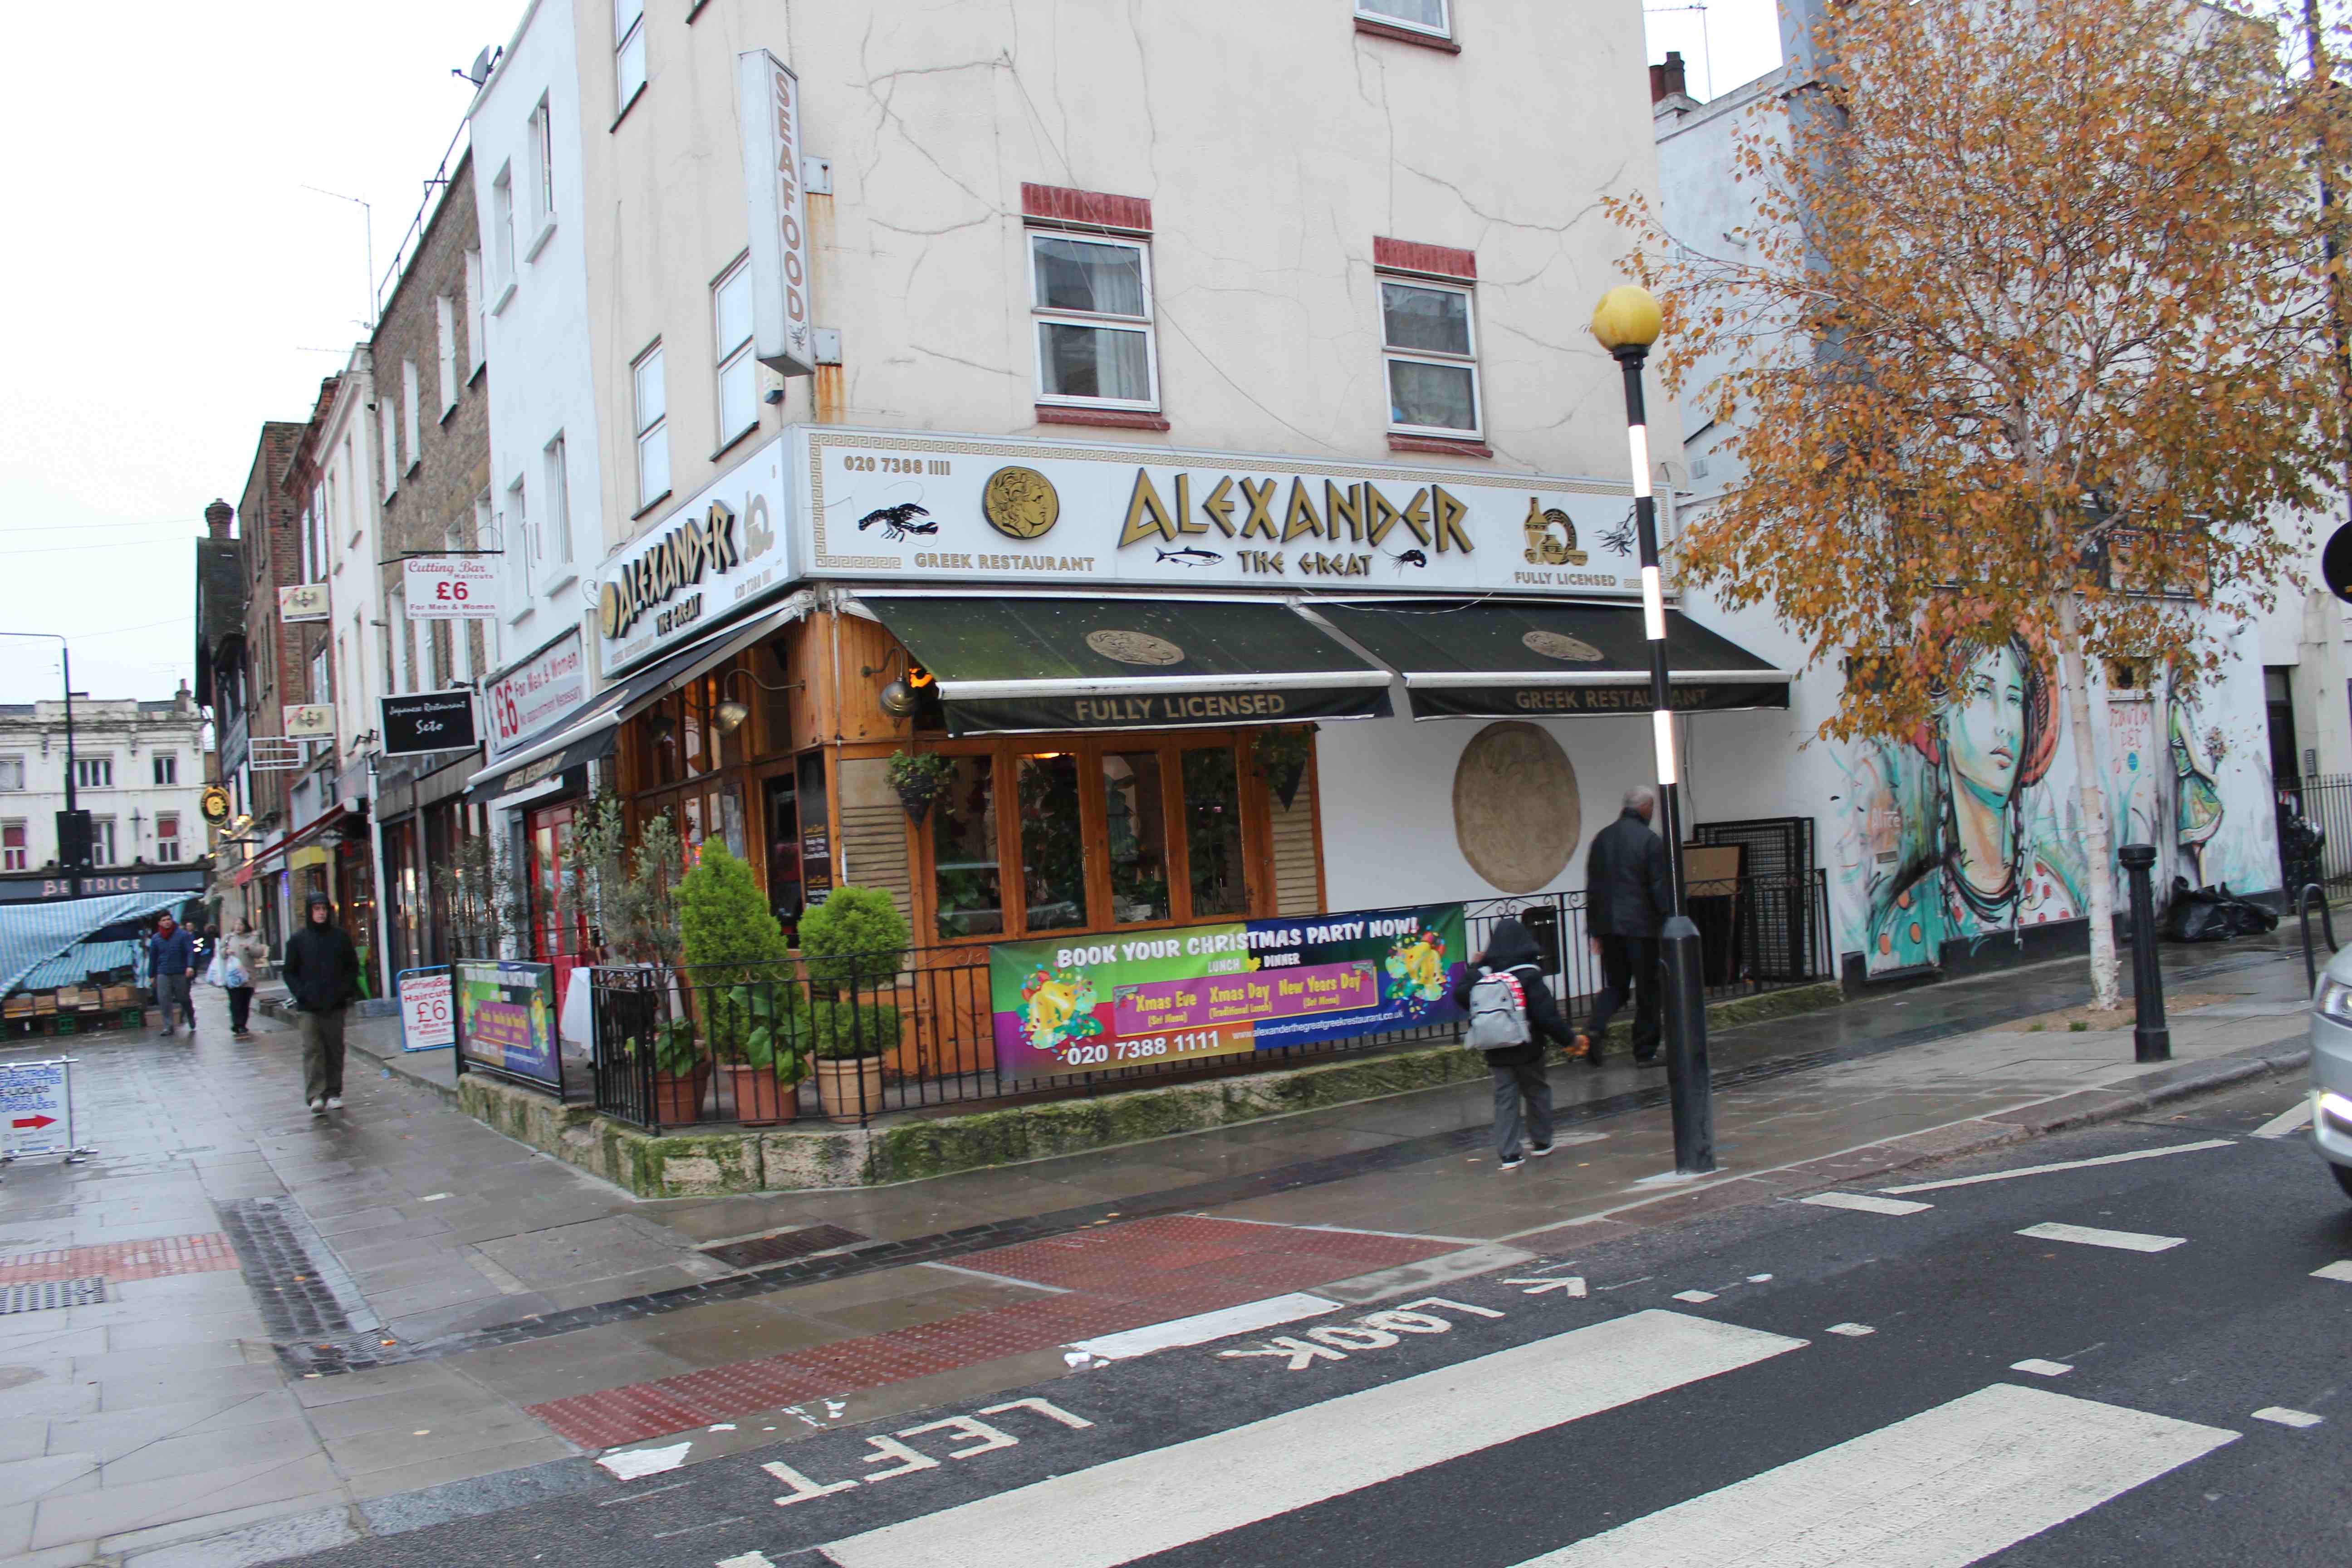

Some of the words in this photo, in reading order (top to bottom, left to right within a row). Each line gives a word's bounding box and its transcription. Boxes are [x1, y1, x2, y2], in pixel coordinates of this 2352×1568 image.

[775, 71, 804, 323] SEAFOOD
[844, 456, 875, 471] 020
[882, 457, 922, 474] 7388
[1117, 467, 1475, 554] ALEXANDER
[409, 560, 454, 576] Cutting
[459, 560, 486, 573] Bar
[618, 499, 739, 638] ALEXANDER
[915, 552, 973, 569] GREEK
[979, 554, 1095, 571] RESTAURANT
[1237, 550, 1285, 574] THE
[1298, 552, 1373, 576] GREAT
[436, 581, 469, 600] £6
[1514, 572, 1552, 585] FULLY
[1557, 573, 1616, 587] LICENSED
[495, 680, 518, 739] £6
[1075, 699, 1153, 721] FULLY
[1164, 694, 1286, 719] LICENSED
[1516, 689, 1580, 708] GREEK
[1585, 688, 1708, 708] RESTAANT
[415, 719, 444, 735] Seto
[42, 876, 140, 897] BETRICE
[1057, 944, 1117, 968] BOOK
[1122, 939, 1181, 959] YOUR
[1187, 928, 1302, 955] CHRISTMAS
[1307, 921, 1366, 945] PARTY
[1369, 916, 1419, 938] NOW!
[1208, 958, 1241, 973] LUNCH
[1263, 952, 1301, 967] DINNER
[1136, 995, 1171, 1012] Xmas
[1176, 991, 1197, 1007] Eve
[1209, 986, 1244, 1003] Xmas
[1247, 982, 1270, 1001] Day
[1278, 977, 1304, 997] New
[1307, 975, 1337, 993] Years
[1340, 973, 1362, 992] Day
[416, 999, 447, 1023] £6
[1067, 1044, 1109, 1066] 020
[1115, 1037, 1167, 1059] 7388
[1173, 1030, 1220, 1052] 1111
[1216, 1296, 1506, 1371] LOOK
[760, 1396, 1096, 1506] LEFT
